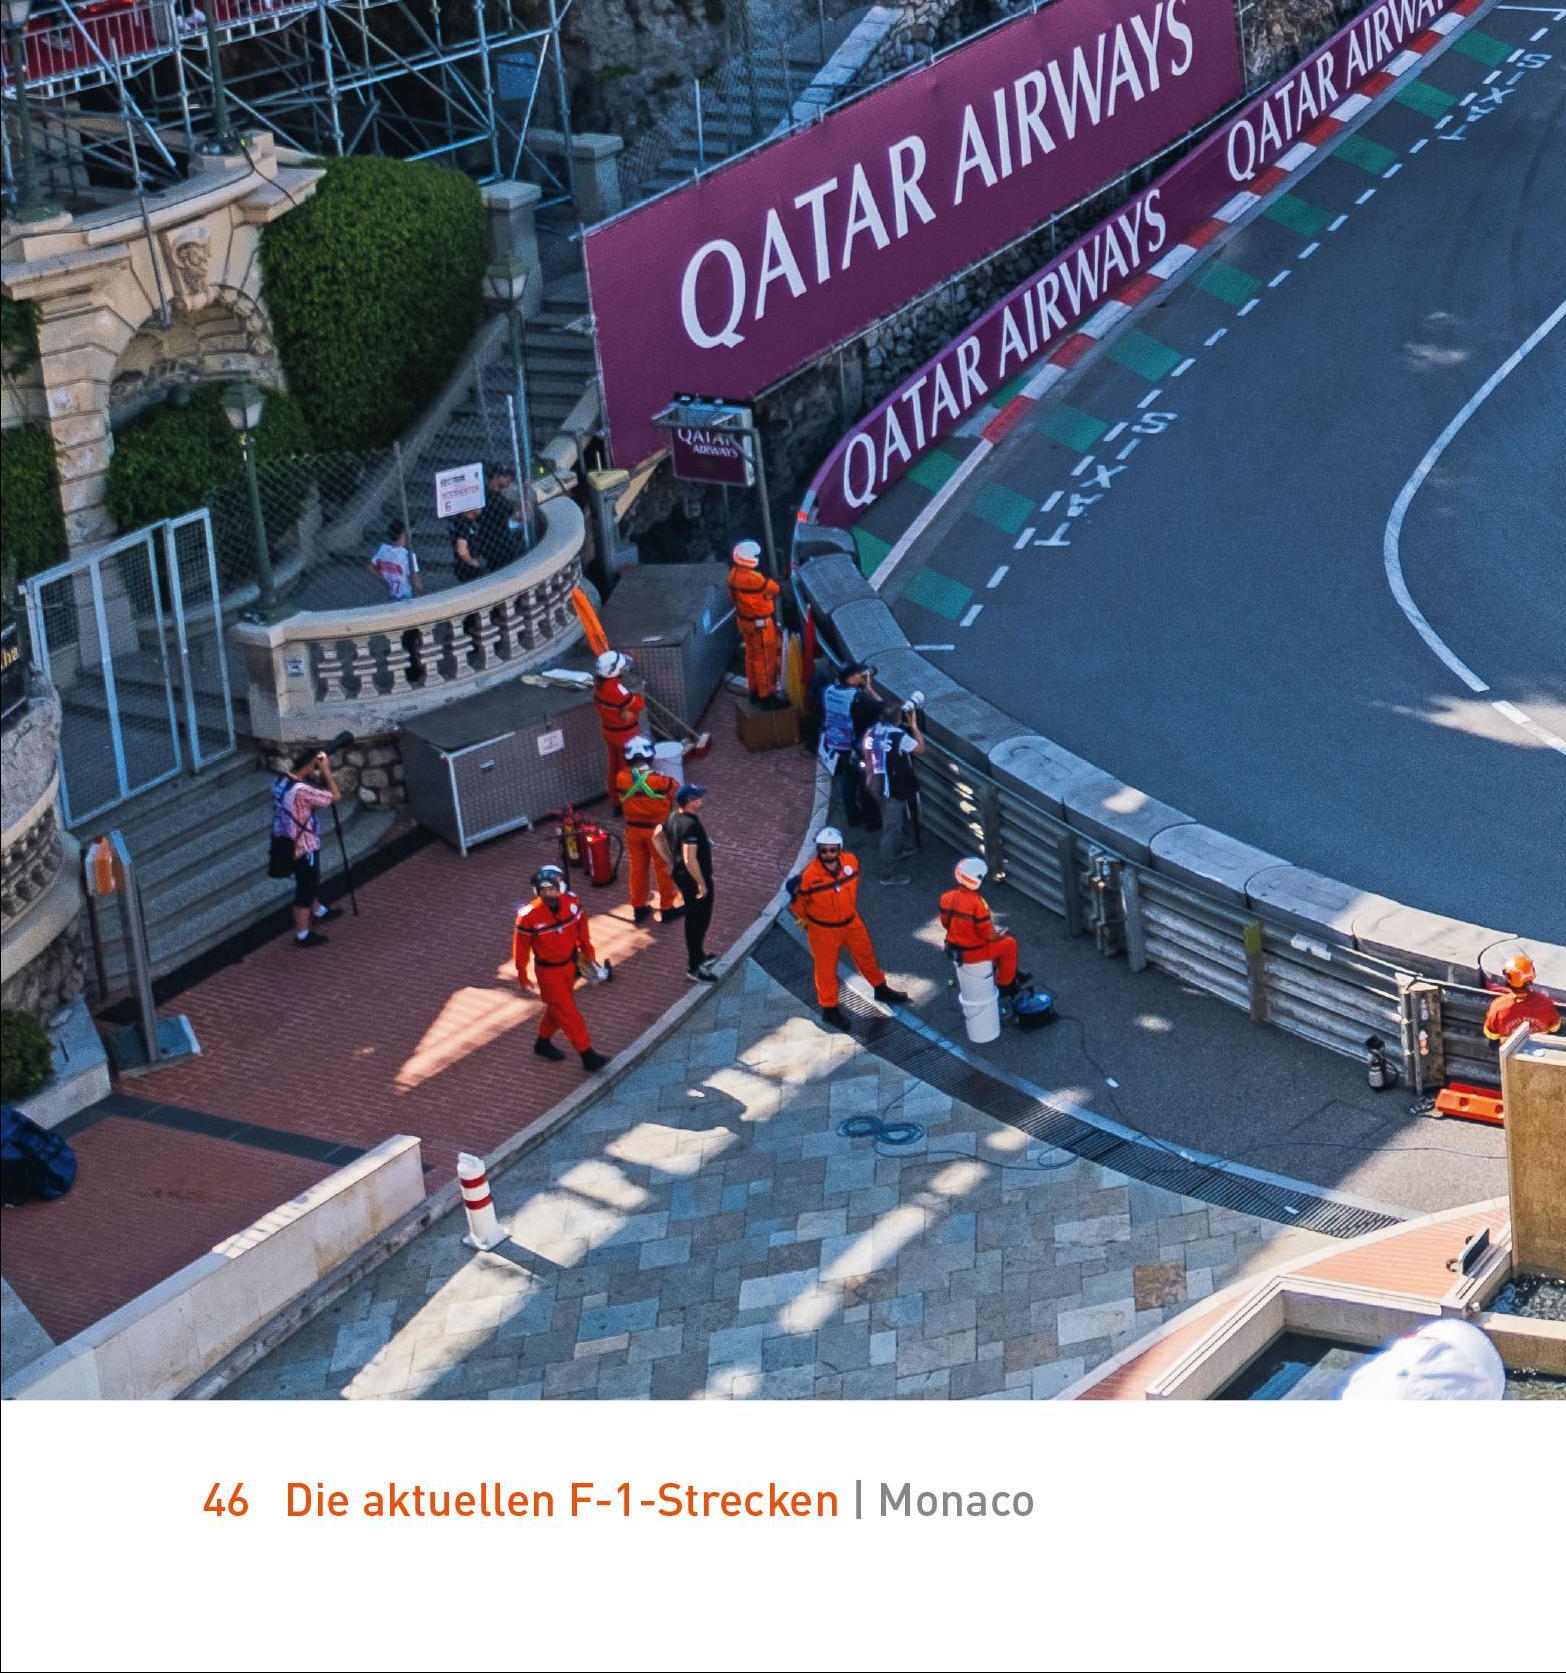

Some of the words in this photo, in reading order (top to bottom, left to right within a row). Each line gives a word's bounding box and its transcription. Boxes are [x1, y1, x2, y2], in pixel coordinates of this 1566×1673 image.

[1226, 50, 1339, 184] QATAR
[680, 134, 938, 351] QATAR
[842, 335, 989, 510] QATAR
[997, 187, 1170, 380] AIRWAYS
